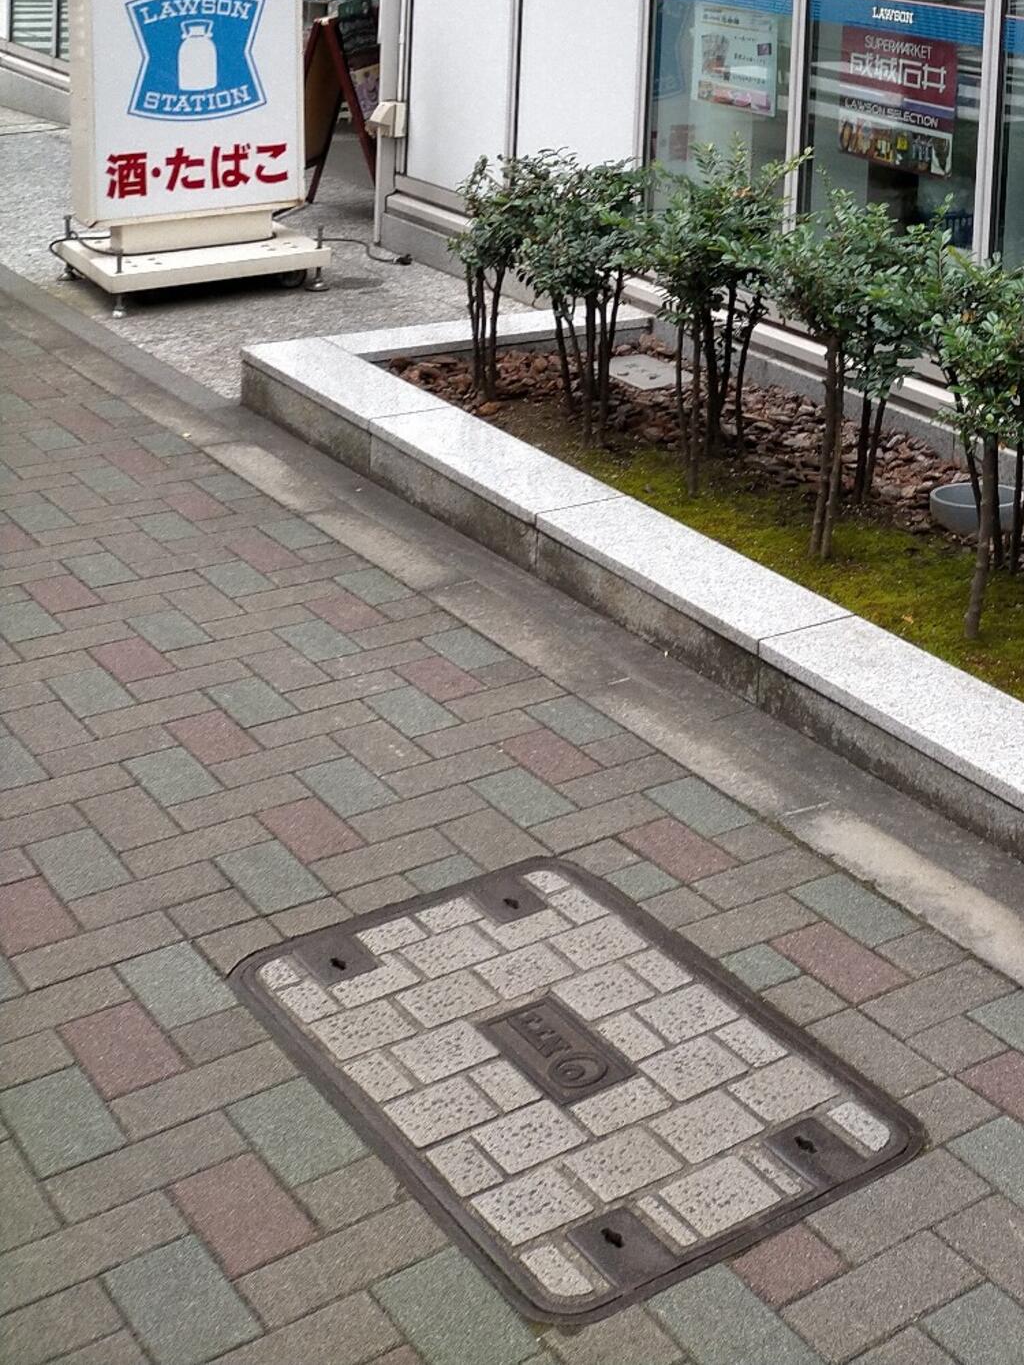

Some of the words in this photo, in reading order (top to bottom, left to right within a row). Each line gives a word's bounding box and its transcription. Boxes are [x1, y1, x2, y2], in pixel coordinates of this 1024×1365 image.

[871, 5, 915, 25] LAWSON
[864, 34, 932, 61] SUPERMARKET
[849, 50, 948, 95] 成城石井
[143, 84, 252, 113] STATION
[844, 96, 889, 117] LAWSON
[886, 106, 939, 128] SELECTION
[105, 141, 289, 199] 酒・たばこ
